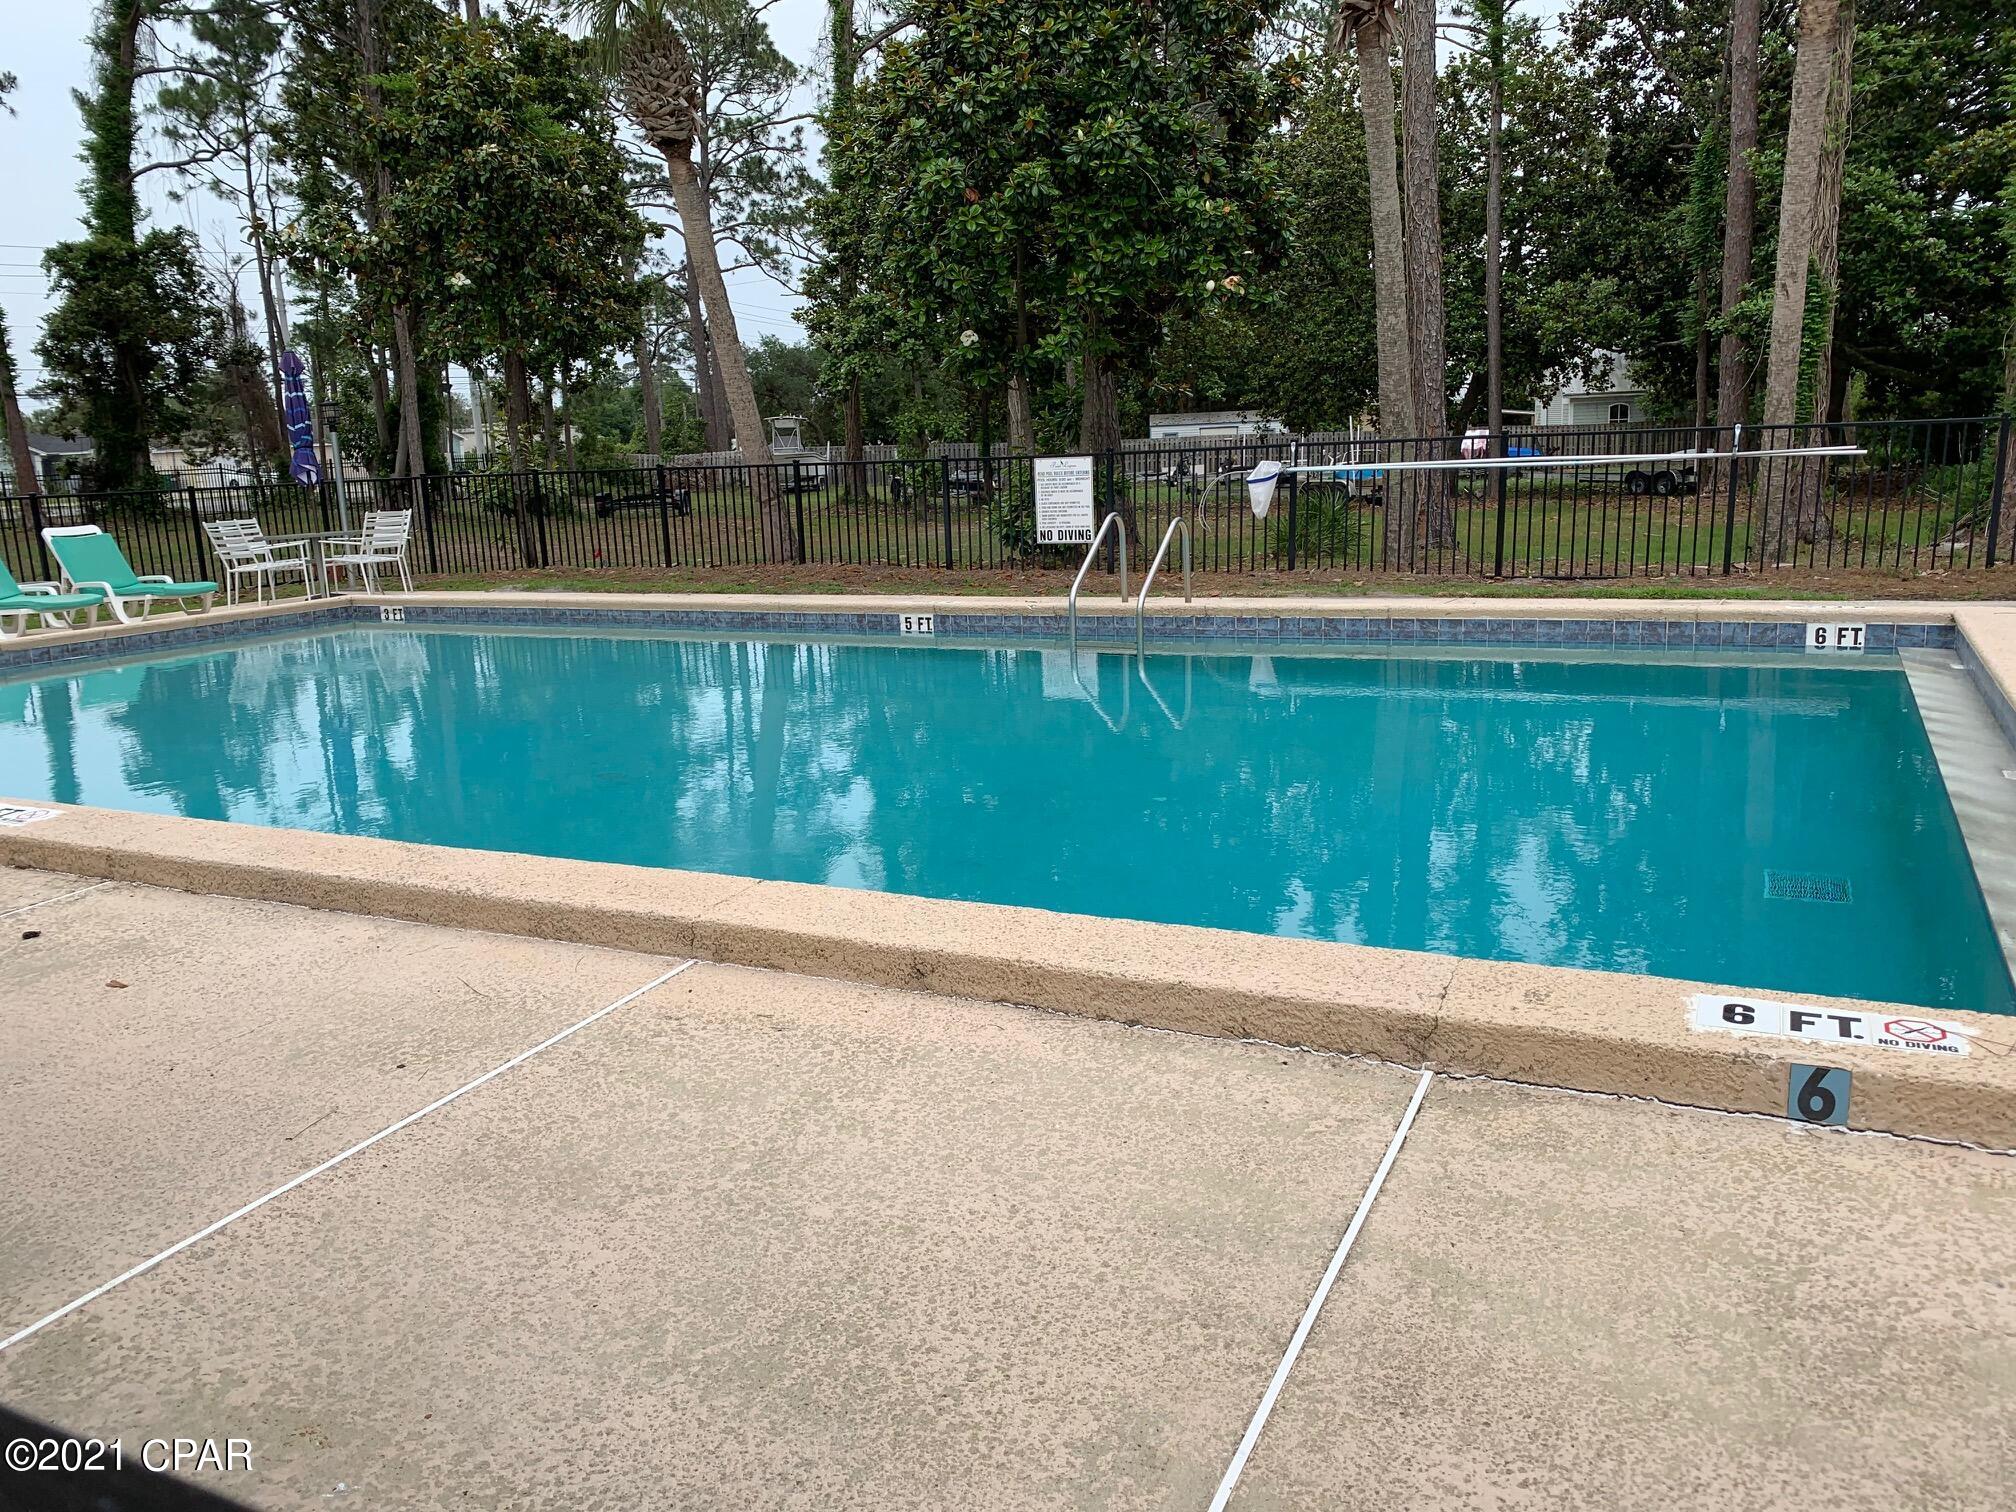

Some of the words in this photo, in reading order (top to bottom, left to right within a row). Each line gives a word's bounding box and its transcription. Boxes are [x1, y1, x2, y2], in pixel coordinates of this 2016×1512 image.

[1040, 529, 1053, 541] NO
[1057, 529, 1092, 541] DIVING
[383, 608, 390, 620] 3
[905, 616, 913, 631] 5
[1814, 626, 1827, 645] 6
[1836, 626, 1863, 646] FT.
[1721, 1003, 1756, 1026] 6
[1789, 1010, 1865, 1040] FT.
[1878, 1038, 1899, 1047] NO
[1905, 1041, 1960, 1053] DIVING
[1797, 1067, 1836, 1122] 6
